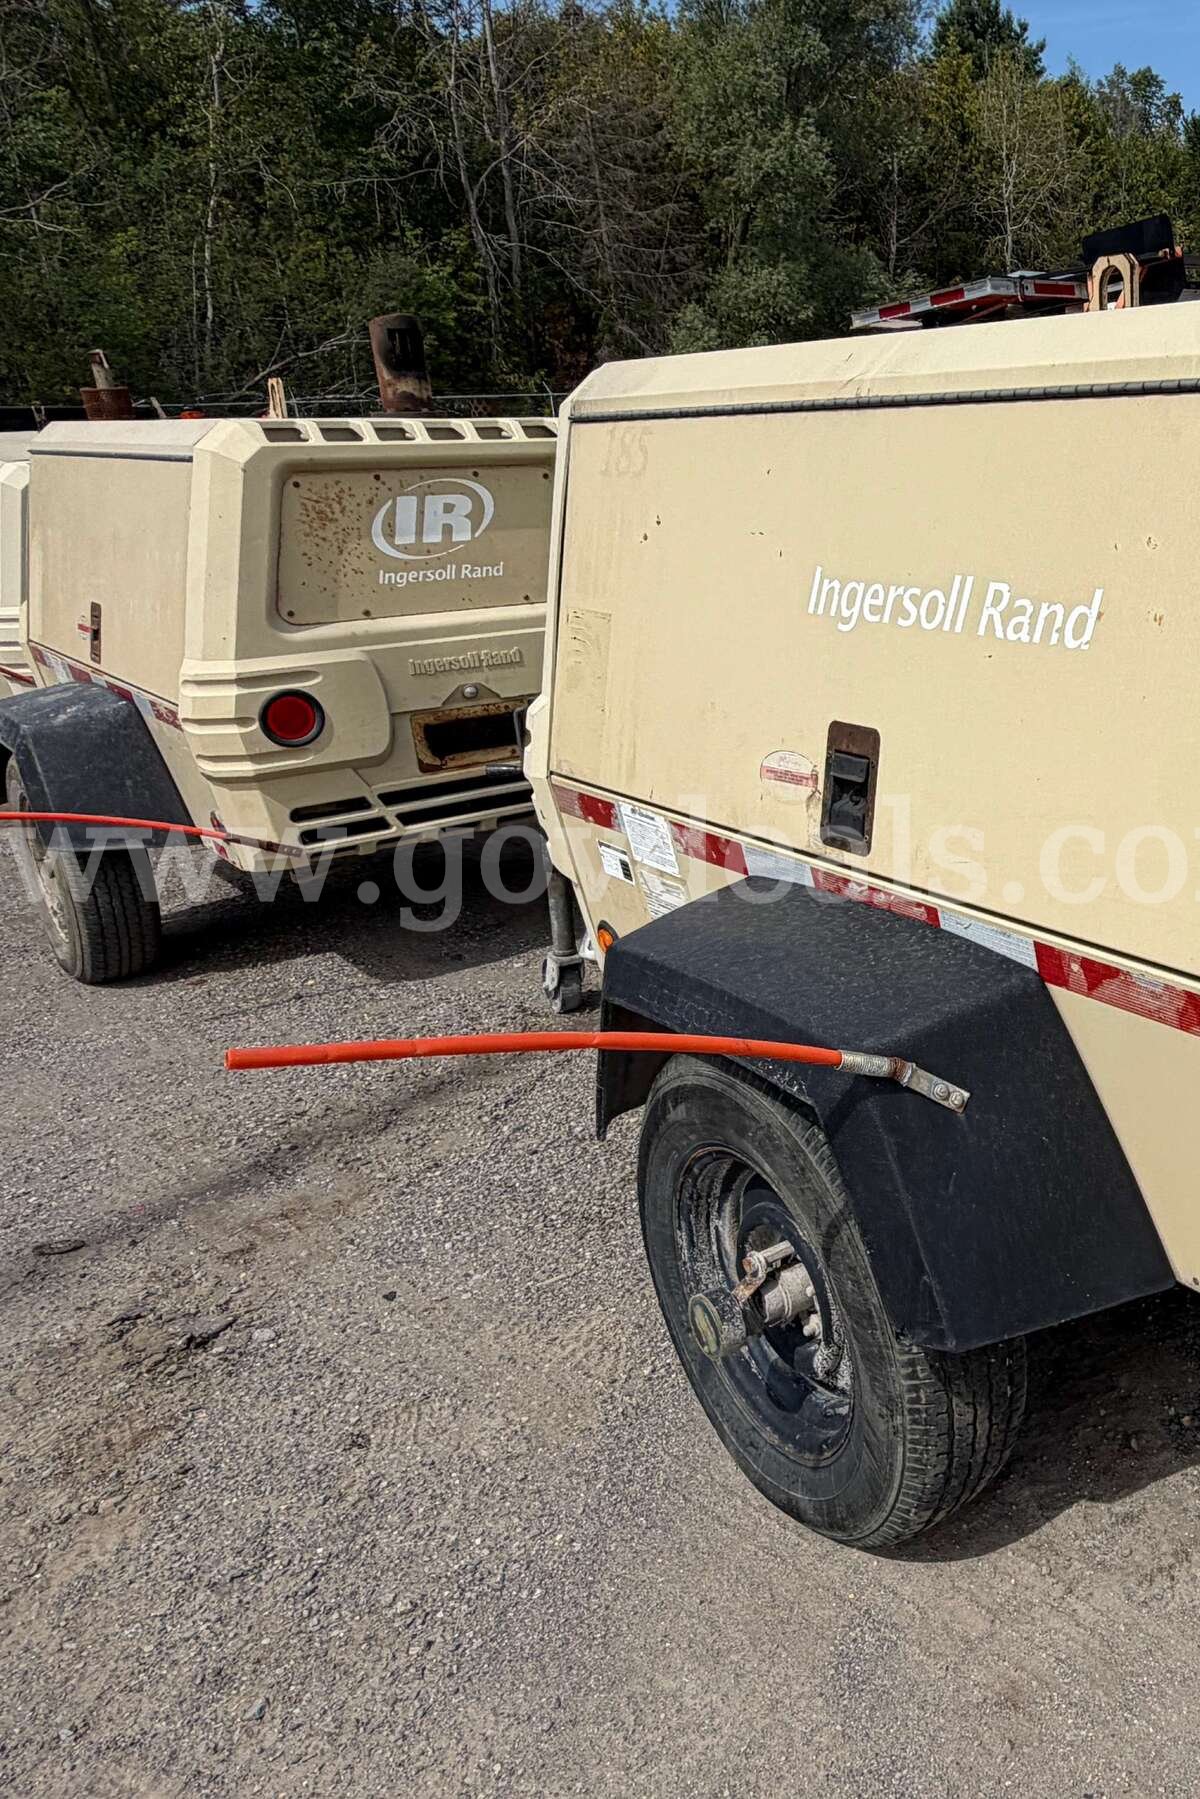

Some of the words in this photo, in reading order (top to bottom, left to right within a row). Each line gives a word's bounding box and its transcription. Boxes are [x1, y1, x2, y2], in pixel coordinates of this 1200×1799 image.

[395, 494, 472, 545] IR
[379, 564, 456, 587] Ingersoll
[461, 561, 503, 579] Rand
[808, 565, 974, 632] Ingersoll
[977, 580, 1104, 650] Rand
